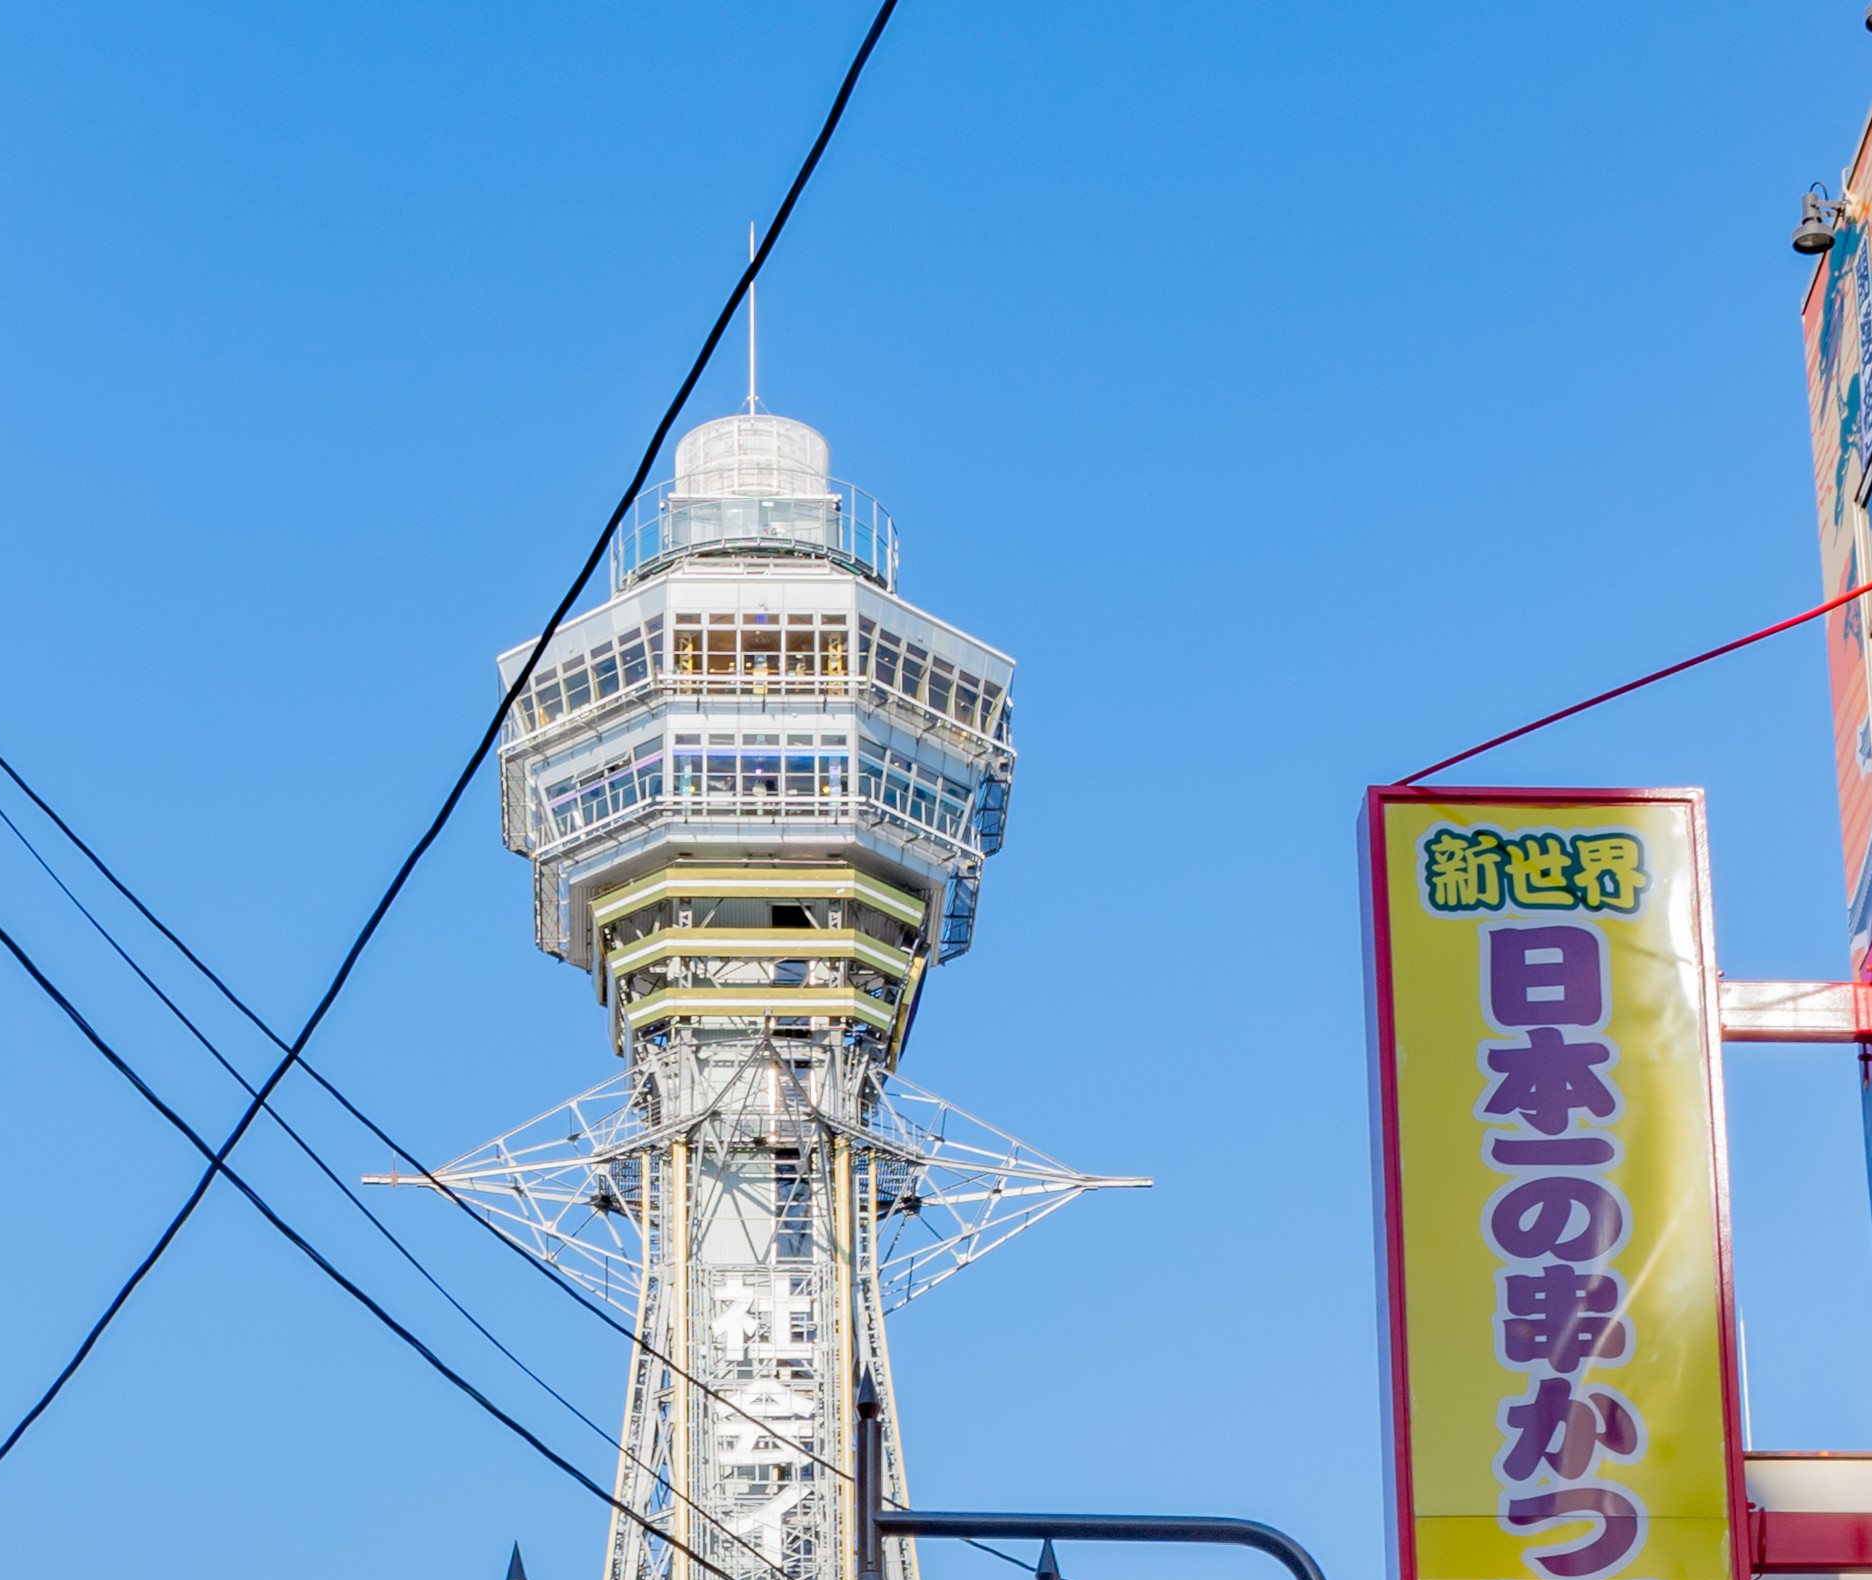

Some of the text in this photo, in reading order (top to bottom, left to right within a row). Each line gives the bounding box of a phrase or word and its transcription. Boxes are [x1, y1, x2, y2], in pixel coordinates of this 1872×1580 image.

[1431, 834, 1647, 909] 新世界
[1484, 925, 1638, 1578] 日本一の串かつ
